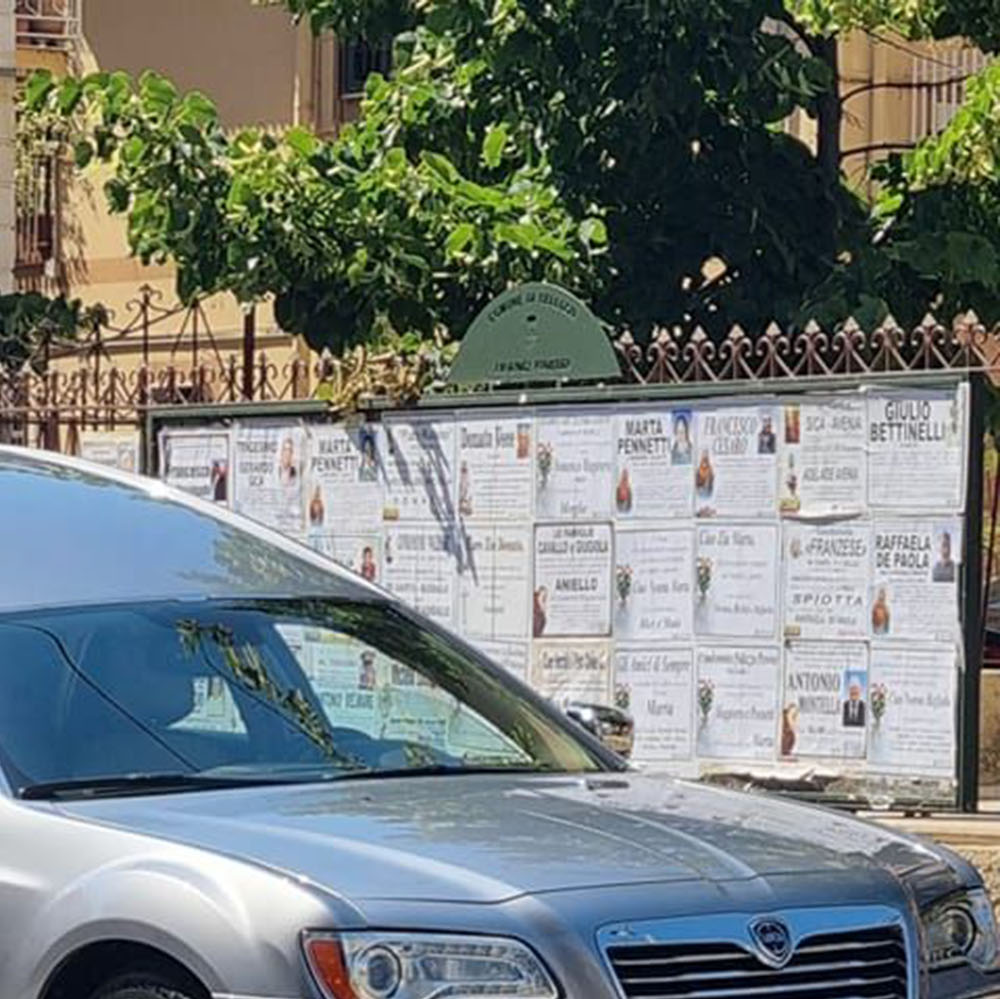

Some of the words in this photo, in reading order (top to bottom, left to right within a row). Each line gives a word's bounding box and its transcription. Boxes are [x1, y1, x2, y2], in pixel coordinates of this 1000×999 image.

[885, 400, 932, 421] GIULIO
[625, 419, 663, 436] MARTA
[870, 421, 945, 442] BETTINELLI
[319, 438, 352, 453] MARTA
[617, 437, 670, 455] PENNETTI
[875, 534, 932, 551] RAFFAELA
[876, 552, 891, 568] DE
[893, 552, 929, 569] PAOLA
[555, 577, 599, 592] ANIELLO
[792, 593, 863, 606] SPIOTTA
[787, 671, 840, 692] ANTONIO
